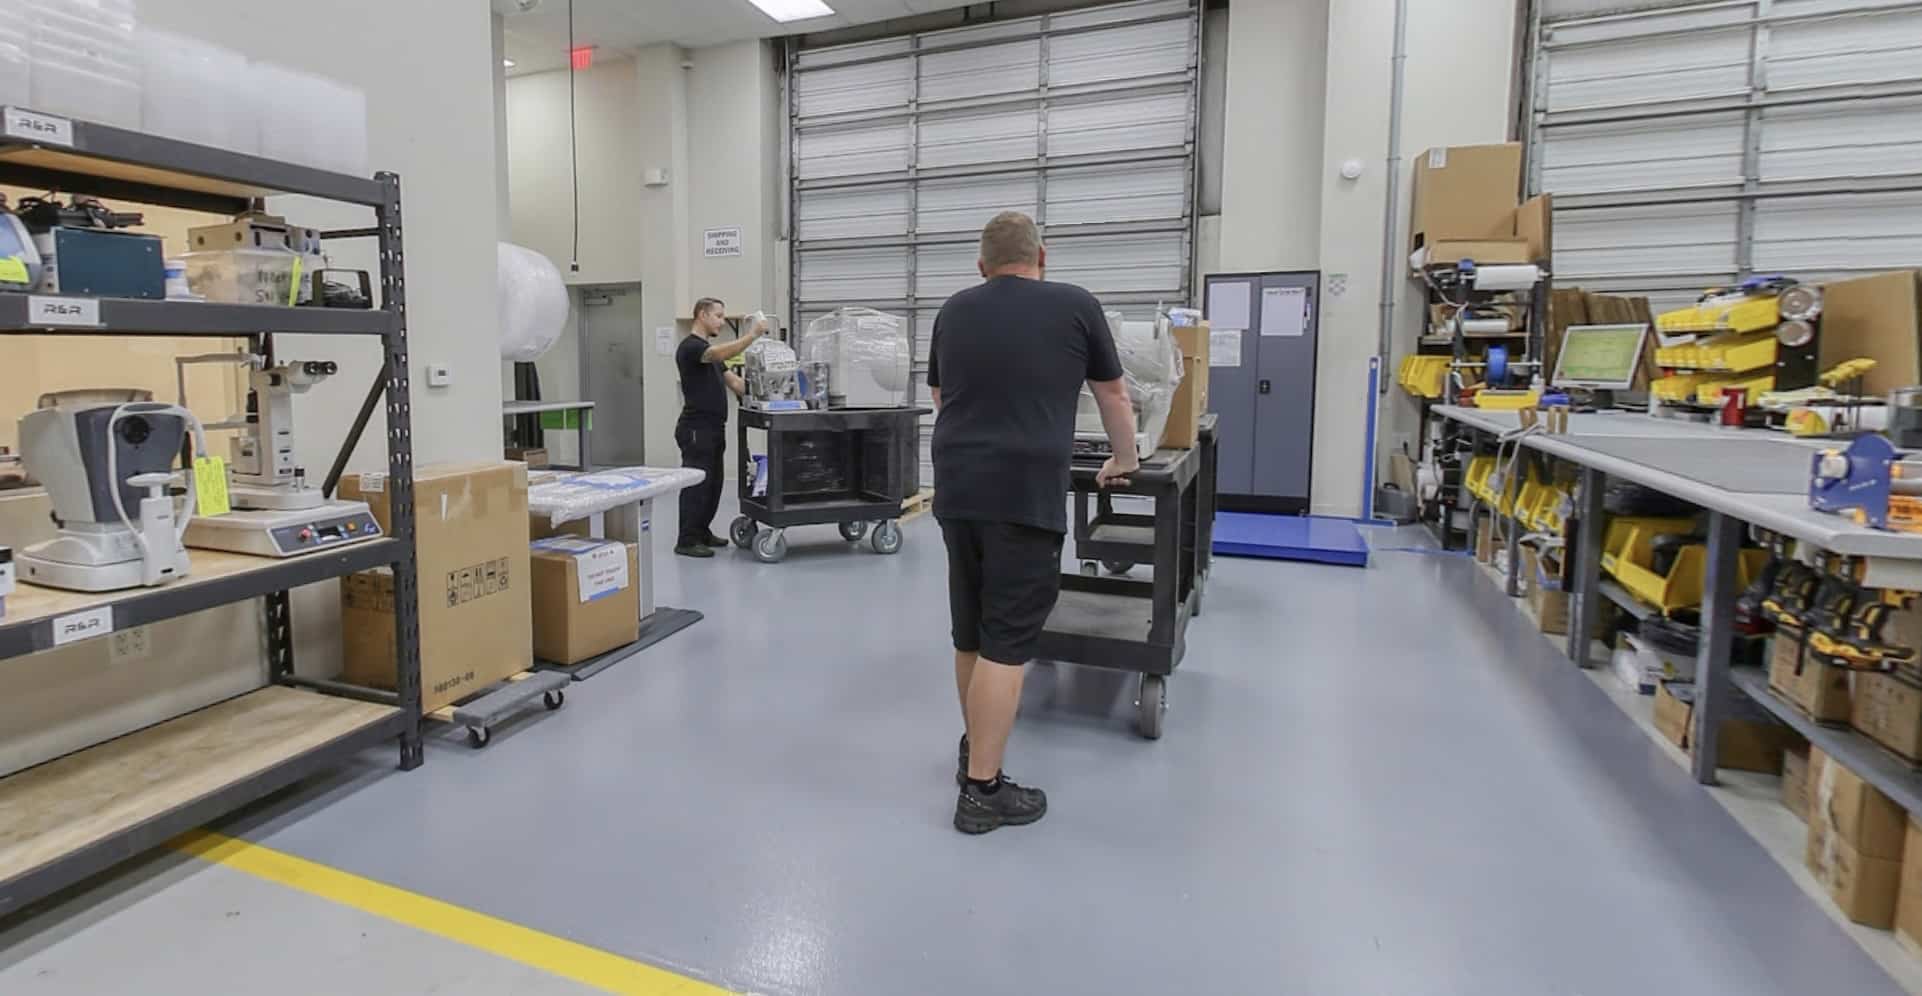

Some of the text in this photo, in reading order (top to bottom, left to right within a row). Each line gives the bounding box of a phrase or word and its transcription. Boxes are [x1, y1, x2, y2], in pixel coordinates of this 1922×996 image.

[18, 118, 57, 134] R&R
[707, 231, 737, 239] SHIPPING
[705, 247, 739, 255] RECEIVING
[43, 303, 82, 315] R&R
[63, 618, 99, 635] R&R
